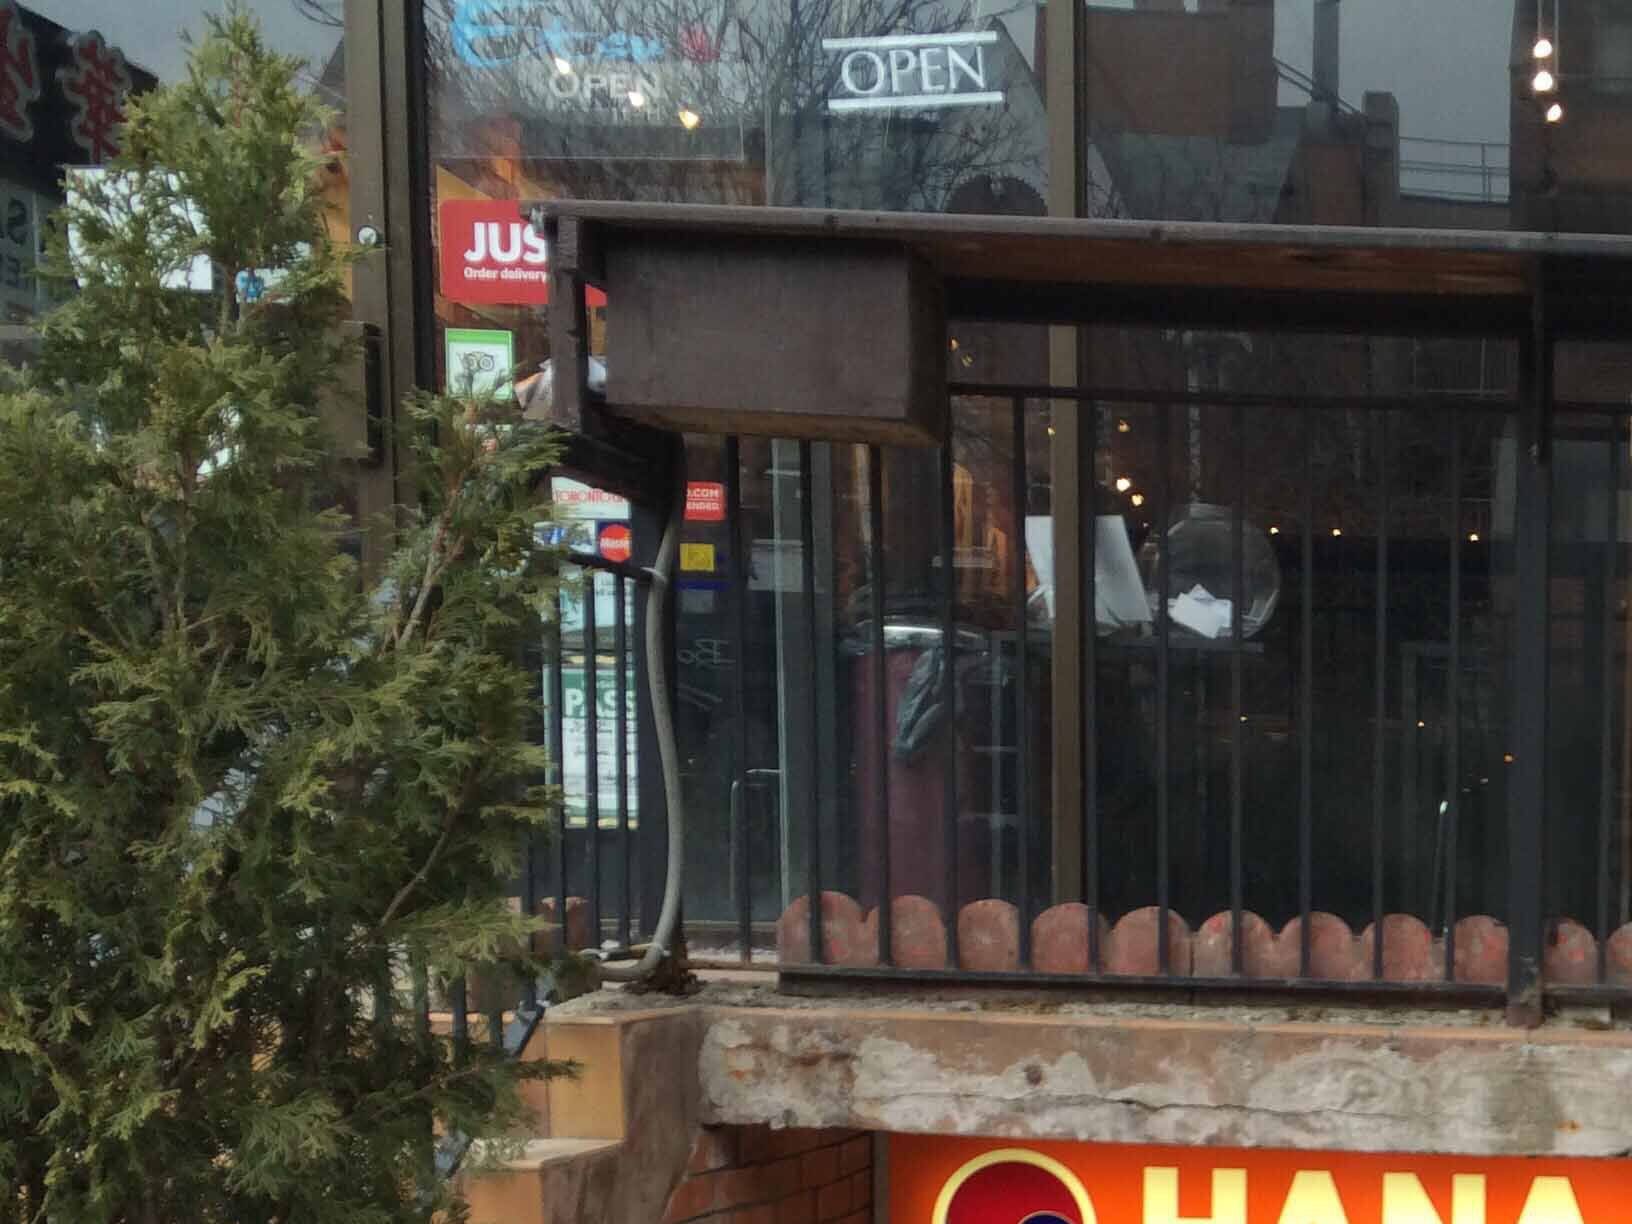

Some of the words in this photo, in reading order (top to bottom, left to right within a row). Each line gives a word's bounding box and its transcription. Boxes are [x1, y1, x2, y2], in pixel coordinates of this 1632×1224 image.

[840, 47, 986, 94] OPEN
[464, 267, 498, 279] Order
[501, 268, 547, 282] delivery
